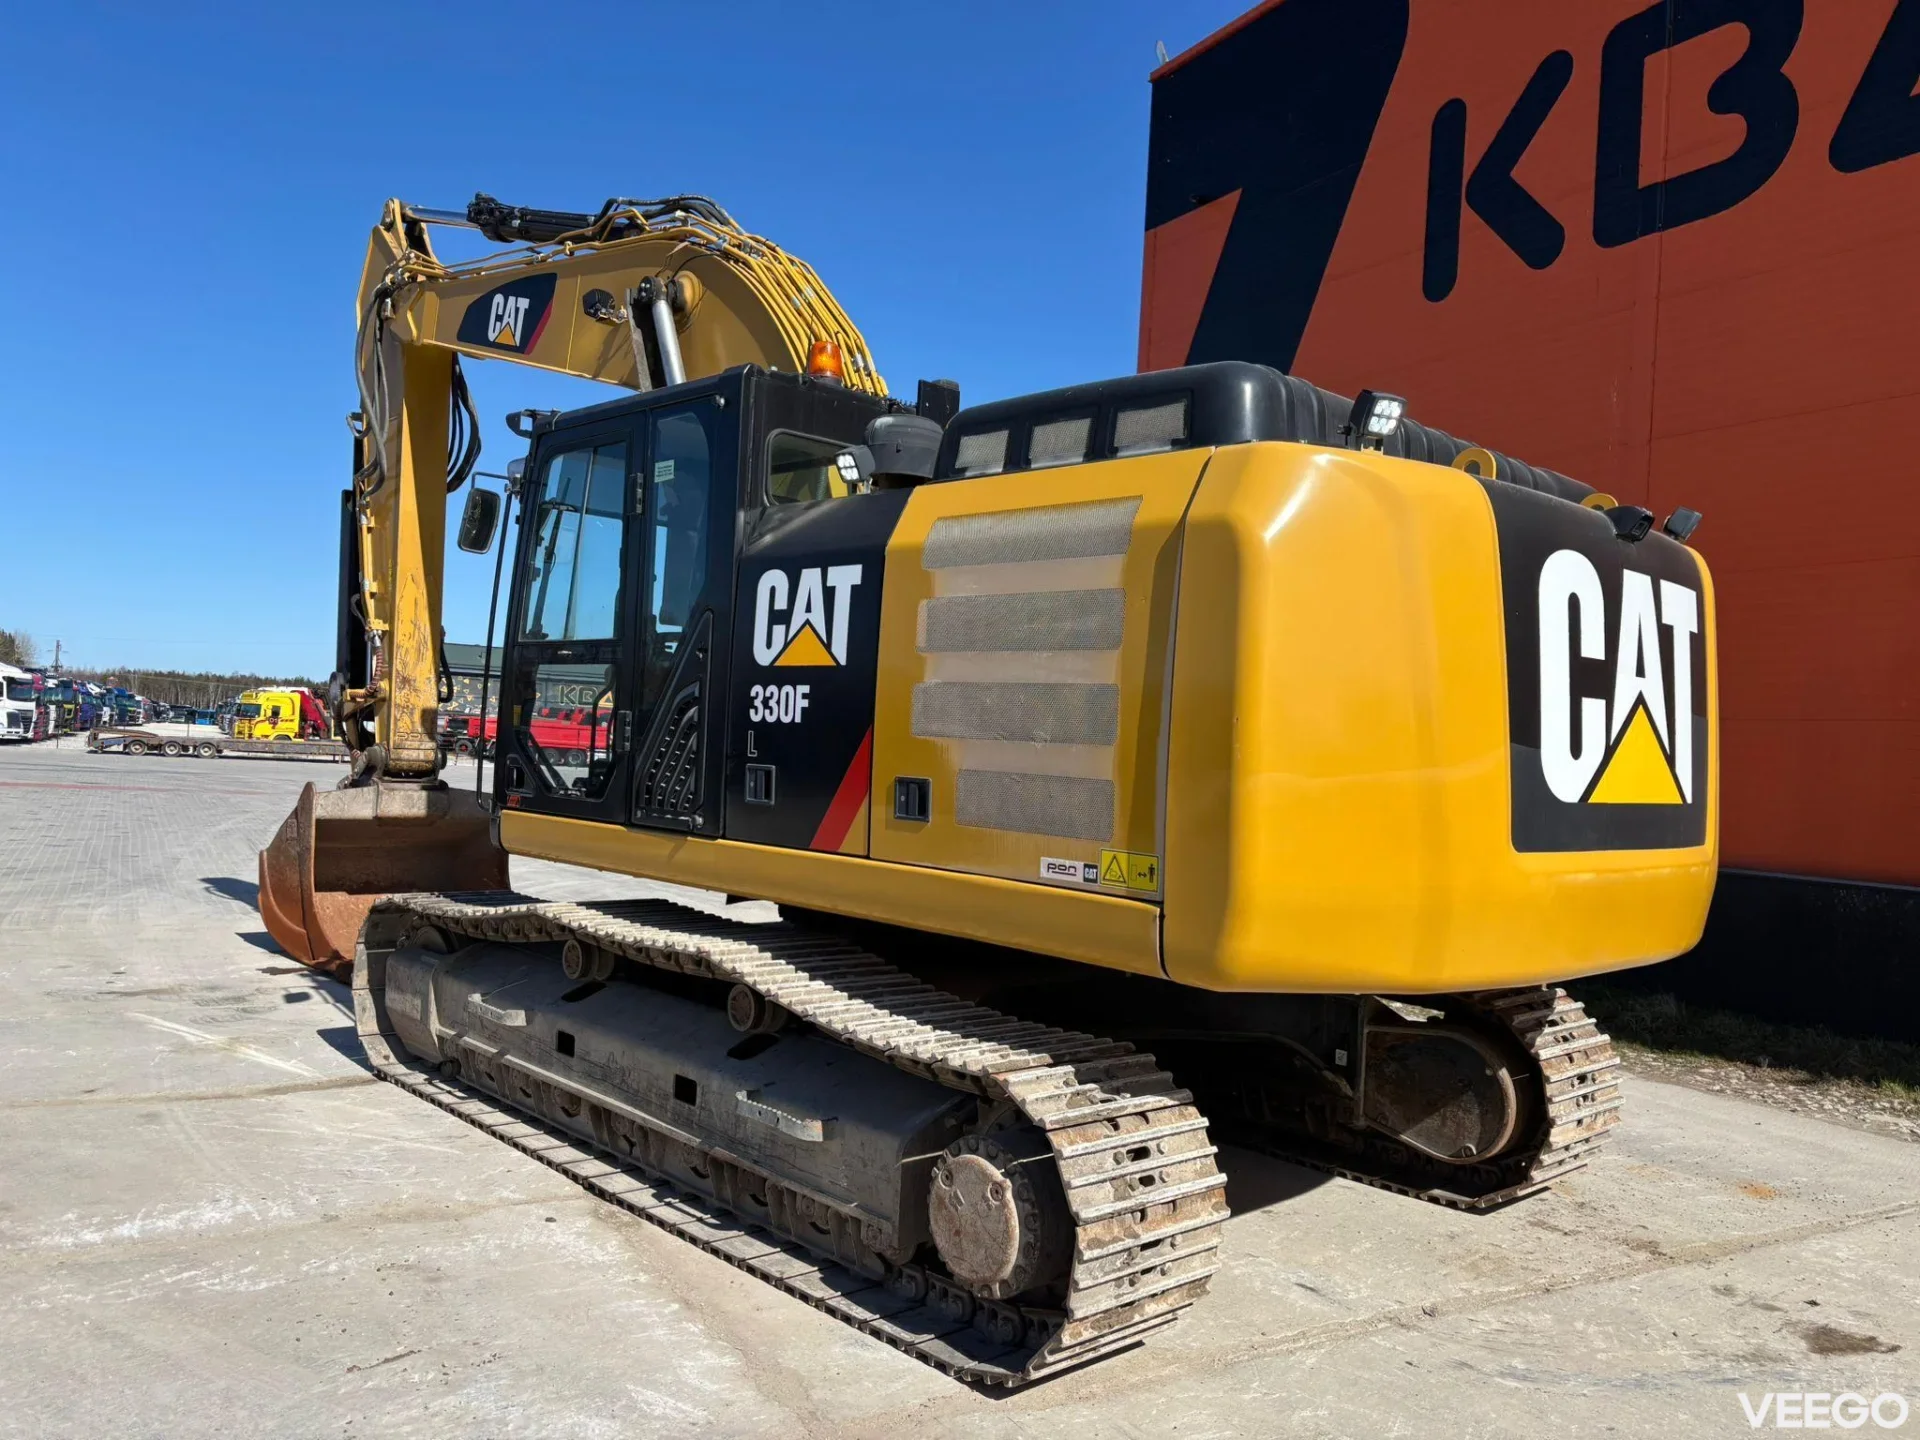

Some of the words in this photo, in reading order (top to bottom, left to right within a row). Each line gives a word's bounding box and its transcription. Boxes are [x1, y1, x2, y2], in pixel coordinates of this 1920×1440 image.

[487, 293, 530, 346] CAT
[753, 564, 863, 666] CAT
[1538, 549, 1698, 804] CAT
[749, 684, 811, 723] 330F
[747, 730, 758, 757] L
